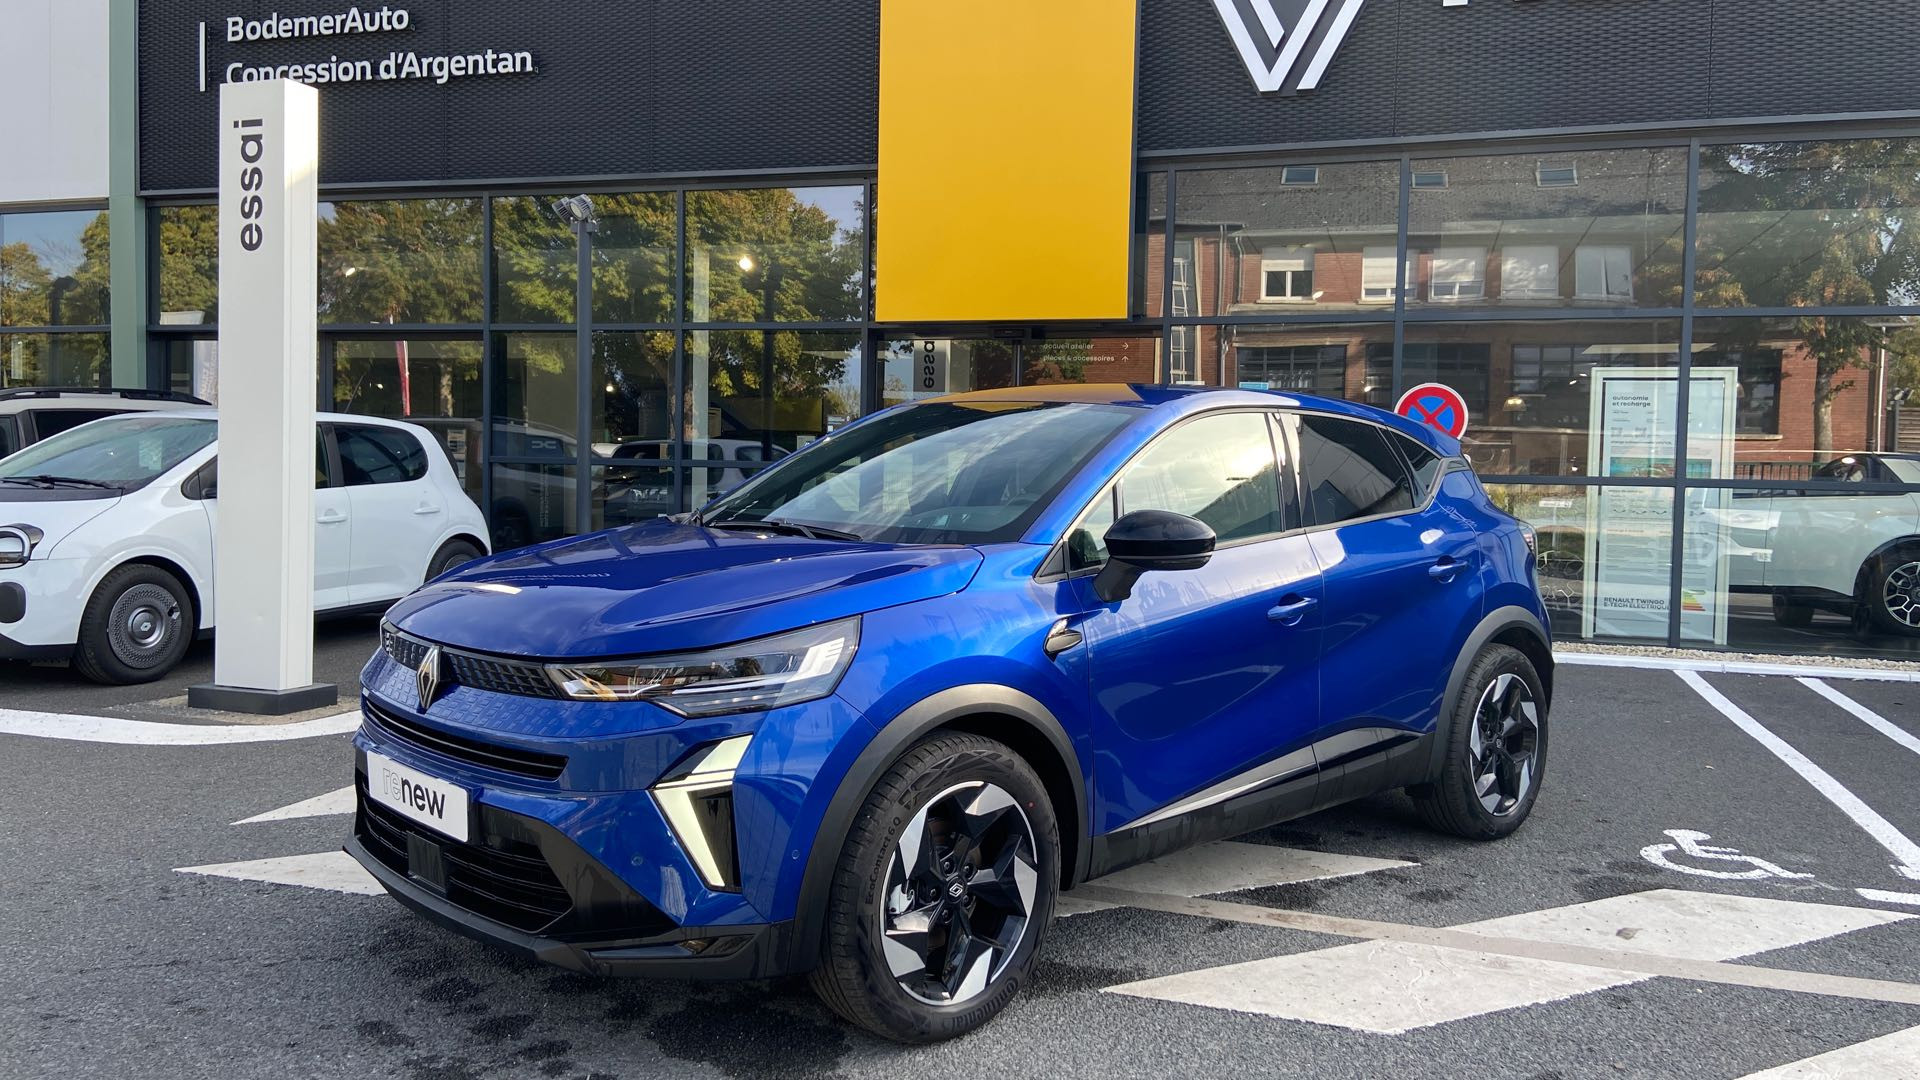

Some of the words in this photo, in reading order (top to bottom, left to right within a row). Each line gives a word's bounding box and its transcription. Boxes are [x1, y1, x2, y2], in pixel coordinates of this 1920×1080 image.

[226, 6, 410, 42] BodemerAuto
[226, 55, 372, 84] Concession
[233, 118, 263, 252] essai
[1072, 354, 1115, 362] accessoires
[382, 767, 446, 820] renew
[864, 836, 891, 905] EcoContact
[951, 975, 1020, 1032] Continental
